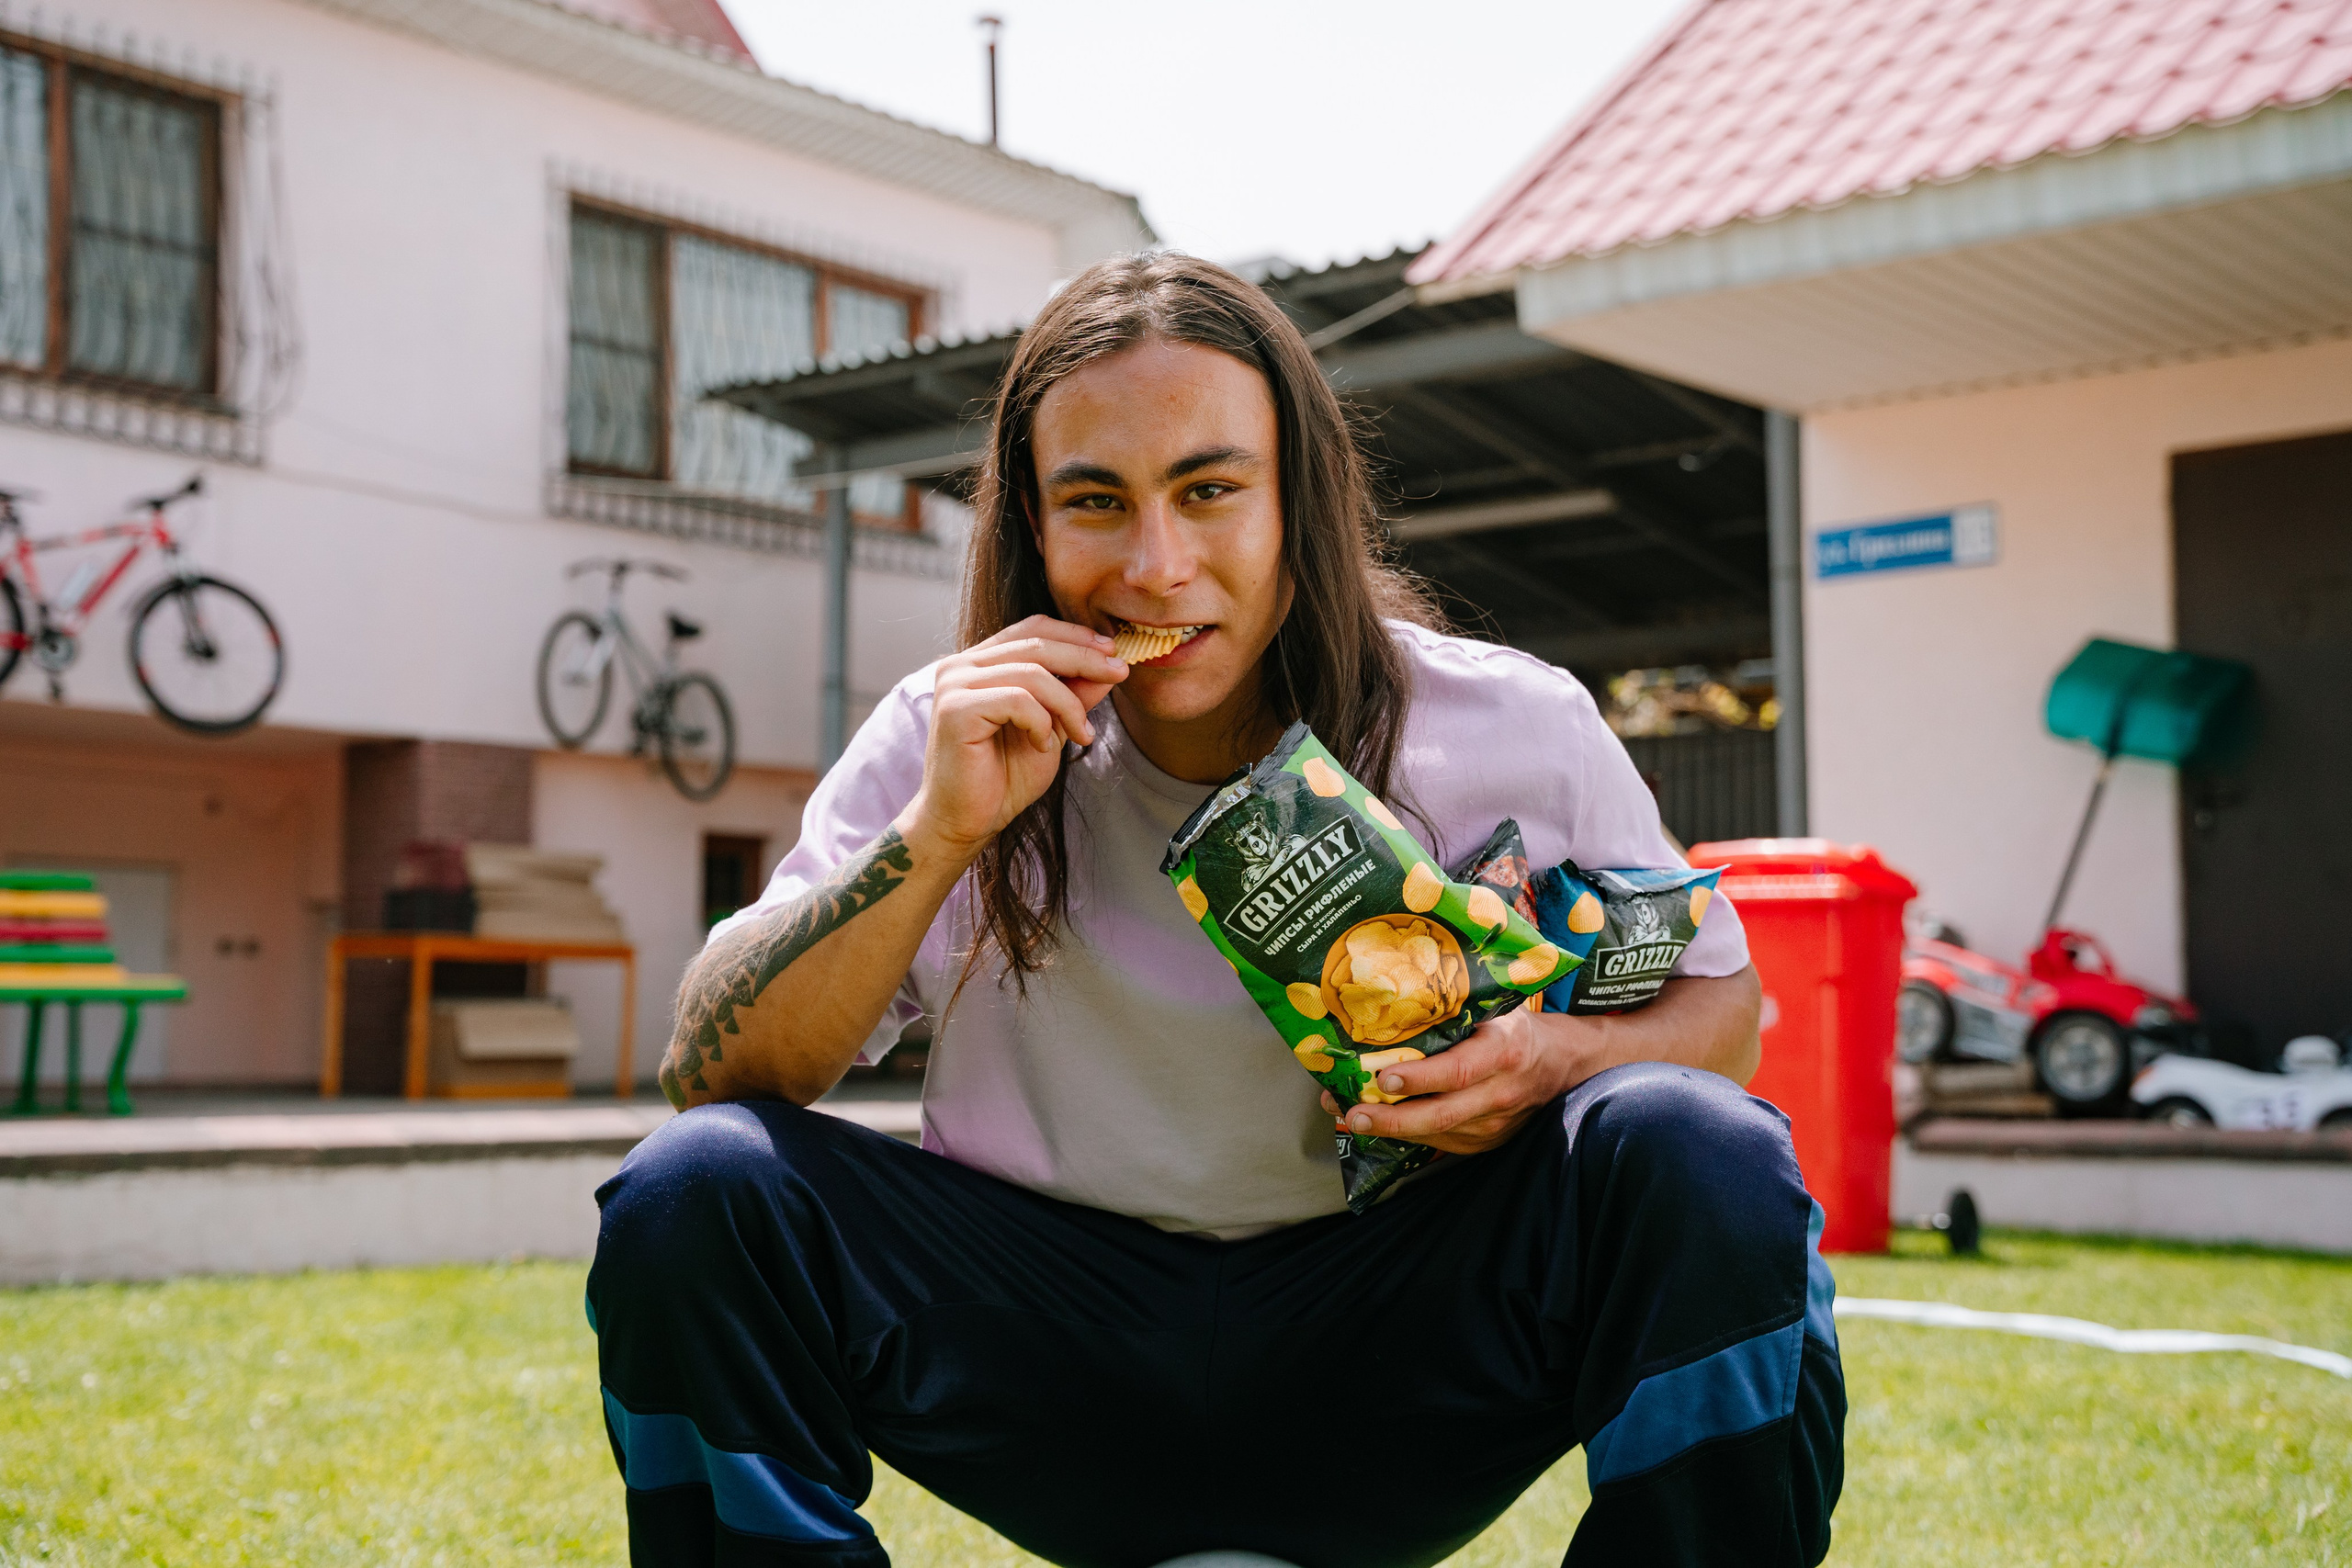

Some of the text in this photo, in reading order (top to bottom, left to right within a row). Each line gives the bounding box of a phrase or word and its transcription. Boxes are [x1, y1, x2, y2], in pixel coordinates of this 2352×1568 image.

[1239, 824, 1354, 932] GRIZZLY
[1264, 858, 1376, 956] ЧИПСЫ РИФЛЕНЫЕ
[1296, 894, 1363, 953] СЫРА И ХАЛАПЕНЬО
[1604, 944, 1684, 976] GRIZZLY
[1589, 984, 1626, 996] ЧИПСЫ
